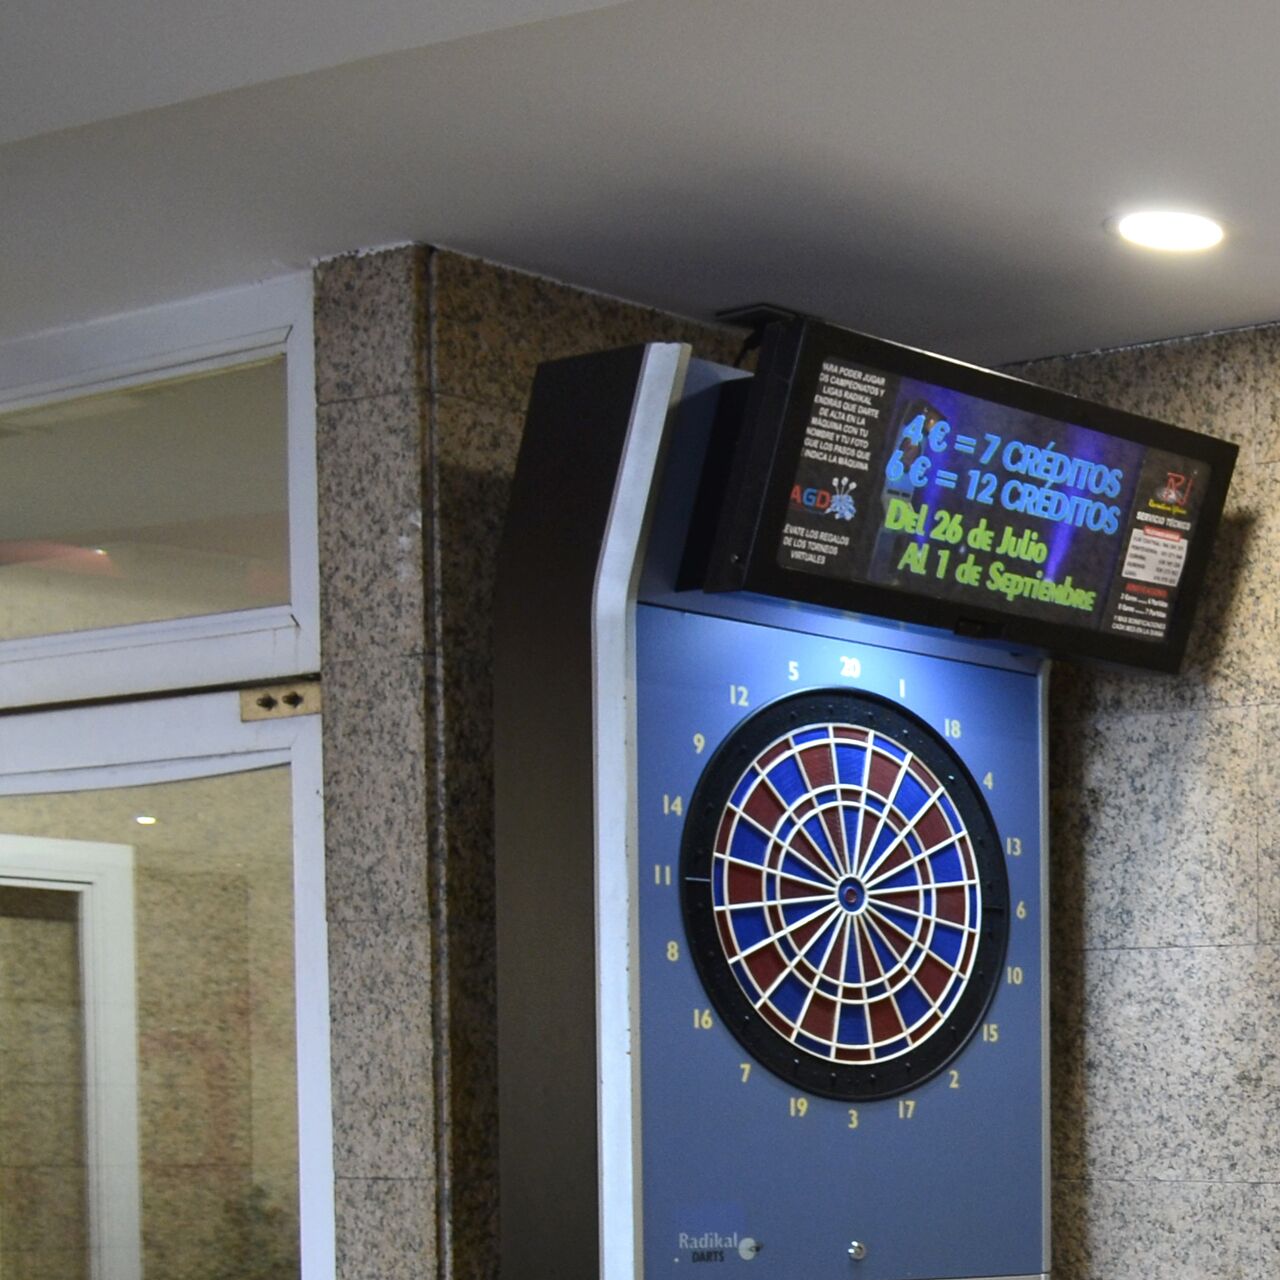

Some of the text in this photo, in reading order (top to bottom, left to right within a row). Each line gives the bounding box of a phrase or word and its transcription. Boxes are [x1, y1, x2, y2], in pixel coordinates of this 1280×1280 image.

[839, 366, 863, 379] PODER
[822, 385, 872, 405] LIGAS RADIKAL
[830, 376, 879, 396] CAMPEONATOS
[829, 410, 846, 421] ALTA
[846, 414, 856, 423] EN
[856, 417, 866, 426] LA
[842, 424, 858, 435] CON
[859, 428, 869, 438] TU
[819, 440, 834, 452] LOS
[901, 414, 926, 447] 4
[928, 420, 951, 453] €
[979, 432, 1002, 465] 7
[1002, 441, 1124, 499] CRÉDITOS
[789, 484, 832, 510] AGD
[885, 449, 905, 482] 6
[909, 456, 932, 488] €
[965, 469, 998, 506] 12
[1000, 479, 1122, 536] CRÉDITOS
[929, 509, 964, 545] 26
[966, 517, 996, 552] de
[995, 525, 1049, 564] Julio
[790, 550, 826, 565] VIRTUALES
[897, 541, 930, 576] Al
[936, 549, 951, 580] 1
[955, 553, 984, 588] de
[985, 561, 1097, 612] Septiembre
[788, 660, 799, 681] 5
[840, 656, 861, 678] 20
[730, 685, 749, 707] 12
[899, 679, 906, 698] 1
[944, 718, 961, 738] 18
[693, 733, 705, 754] 9
[983, 772, 993, 790] 4
[663, 794, 683, 816] 14
[1006, 837, 1021, 856] 13
[654, 864, 671, 886] 11
[1016, 901, 1026, 919] 6
[666, 941, 679, 962] 8
[1007, 967, 1023, 985] 10
[694, 1009, 713, 1029] 16
[983, 1024, 998, 1042] 15
[740, 1063, 751, 1083] 7
[949, 1070, 959, 1089] 2
[790, 1097, 808, 1117] 19
[899, 1100, 915, 1119] 17
[848, 1109, 858, 1129] 3
[679, 1232, 738, 1249] Radikal
[692, 1250, 725, 1263] DARTS
